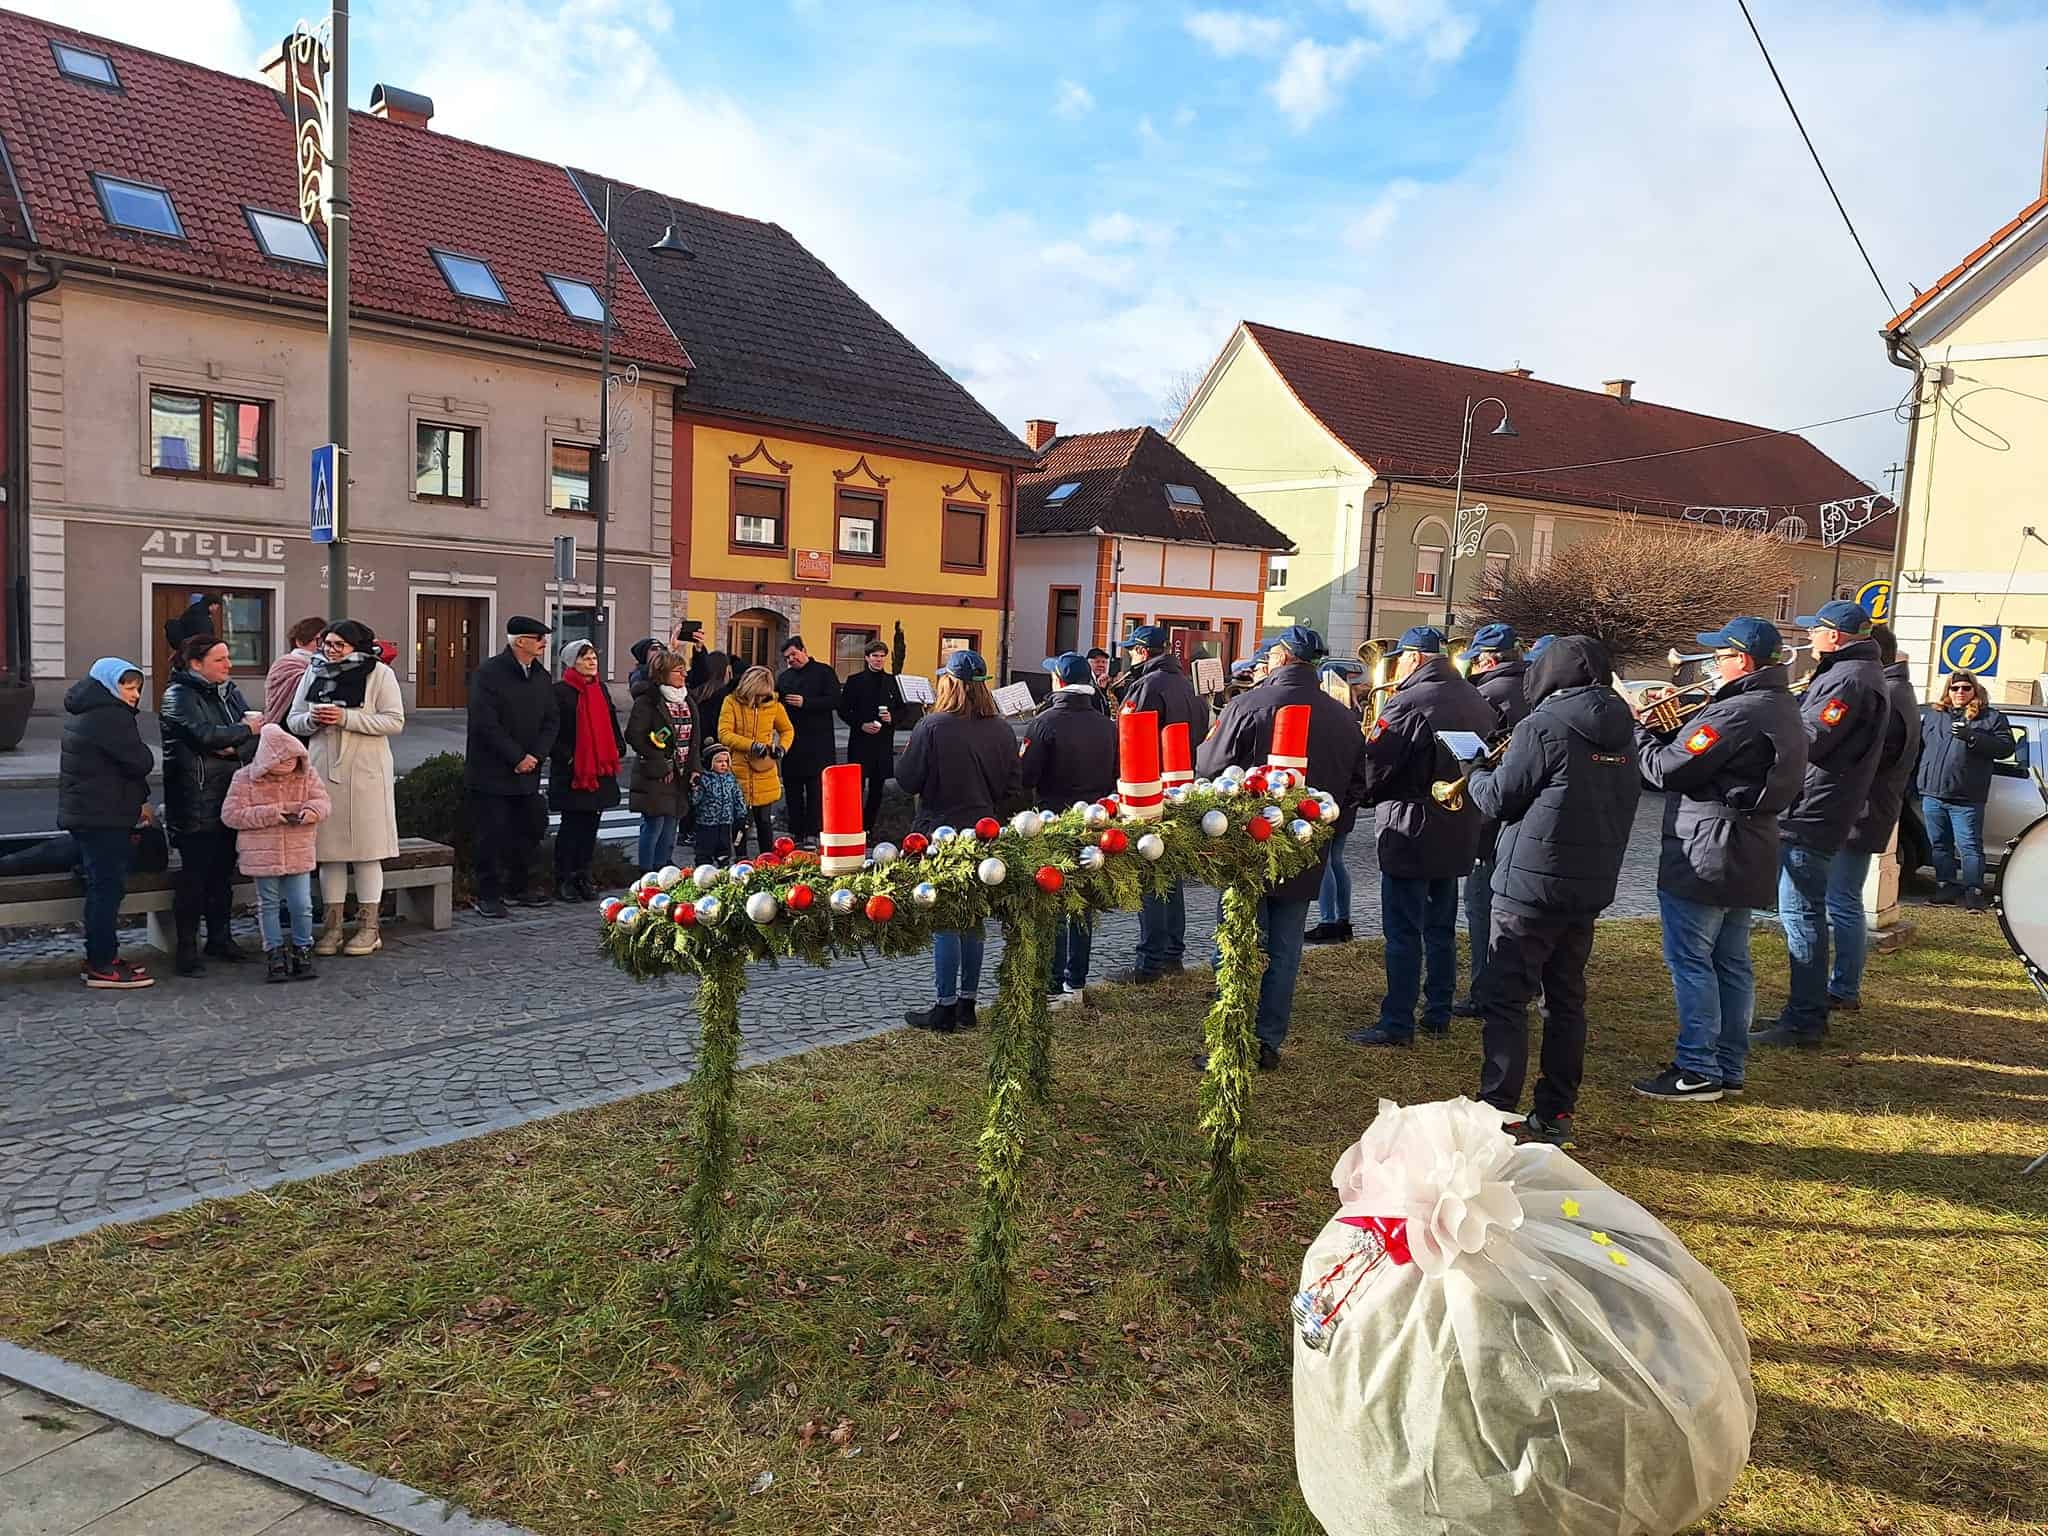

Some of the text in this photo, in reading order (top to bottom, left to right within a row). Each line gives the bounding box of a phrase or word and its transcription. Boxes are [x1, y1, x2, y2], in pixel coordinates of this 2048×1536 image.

[141, 529, 286, 560] ATELJE
[1871, 585, 1889, 618] i
[1958, 634, 1981, 668] i
